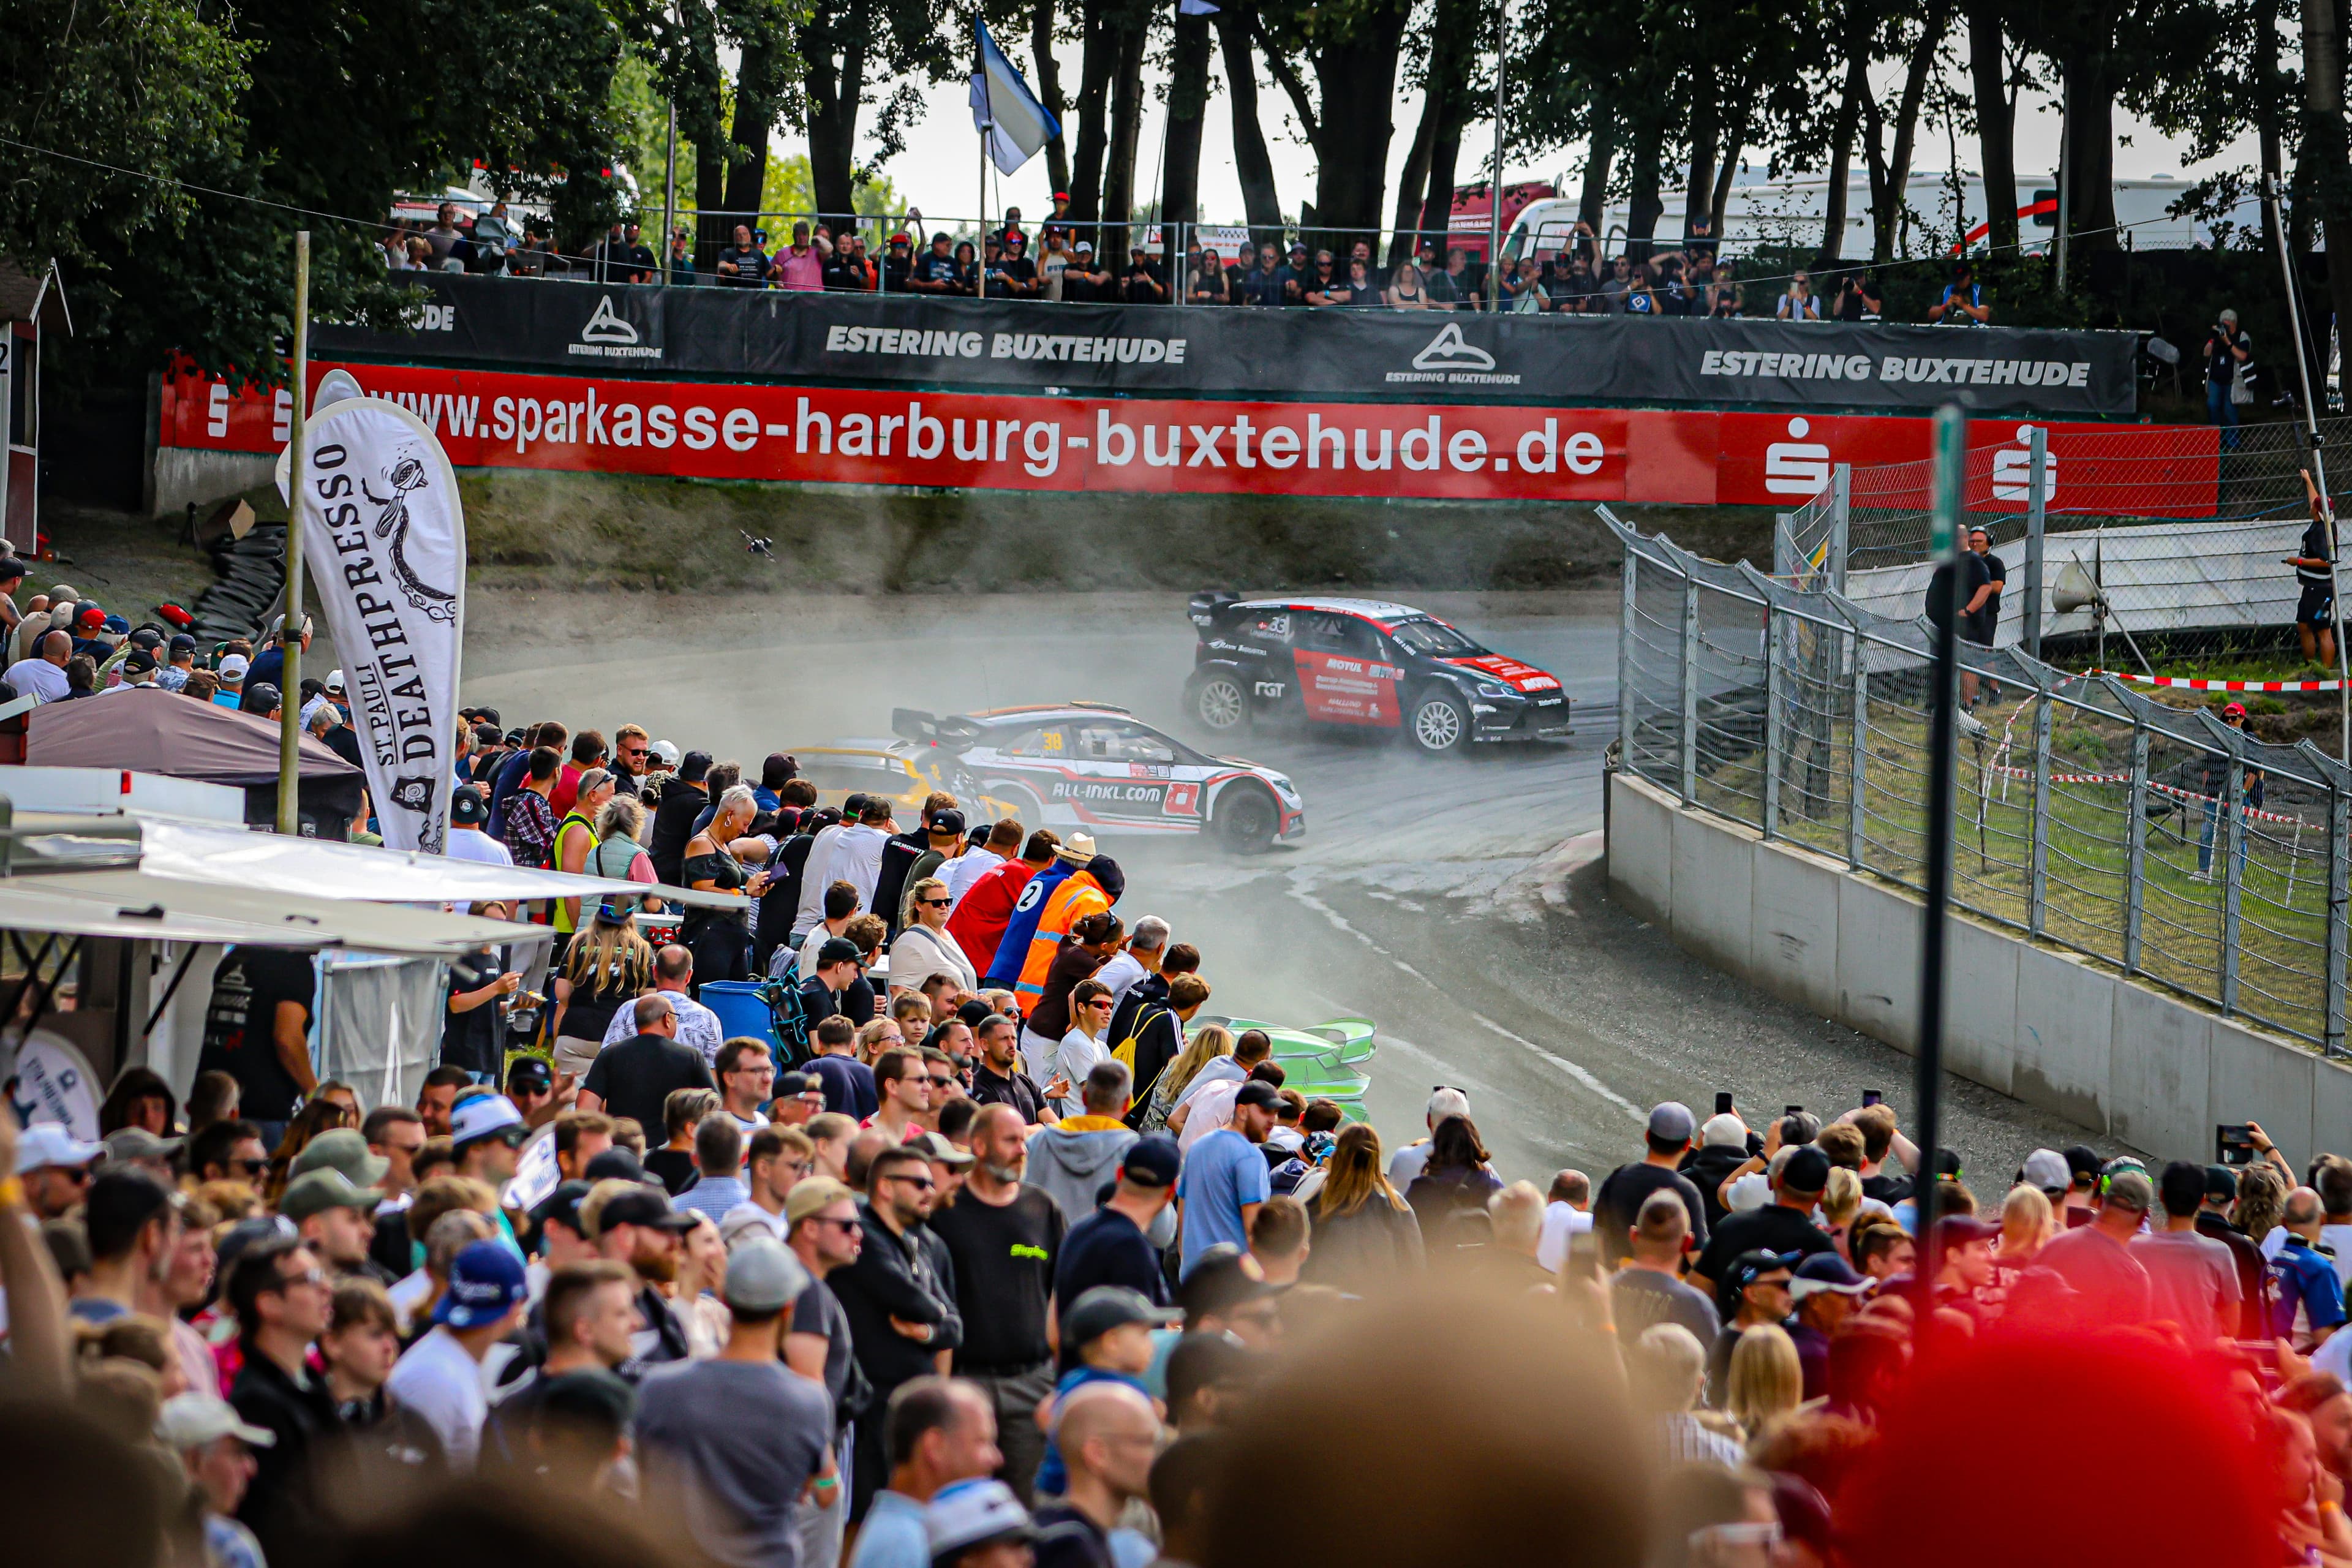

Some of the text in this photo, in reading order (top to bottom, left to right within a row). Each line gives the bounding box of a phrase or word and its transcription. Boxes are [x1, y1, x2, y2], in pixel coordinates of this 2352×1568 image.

[604, 346, 662, 358] BUXTEHUDE
[826, 325, 1187, 364] ESTERING BUXTEHUDE
[1385, 372, 1521, 385] ESTERING BUXTEHUDE
[1701, 350, 2091, 388] ESTERING BUXTEHUDE
[313, 443, 436, 764] DEATHPRESSO
[1327, 658, 1362, 673] MOTUL
[355, 665, 396, 766] ST. PAULI
[1042, 732, 1063, 751] 38
[1019, 885, 1038, 908] 2
